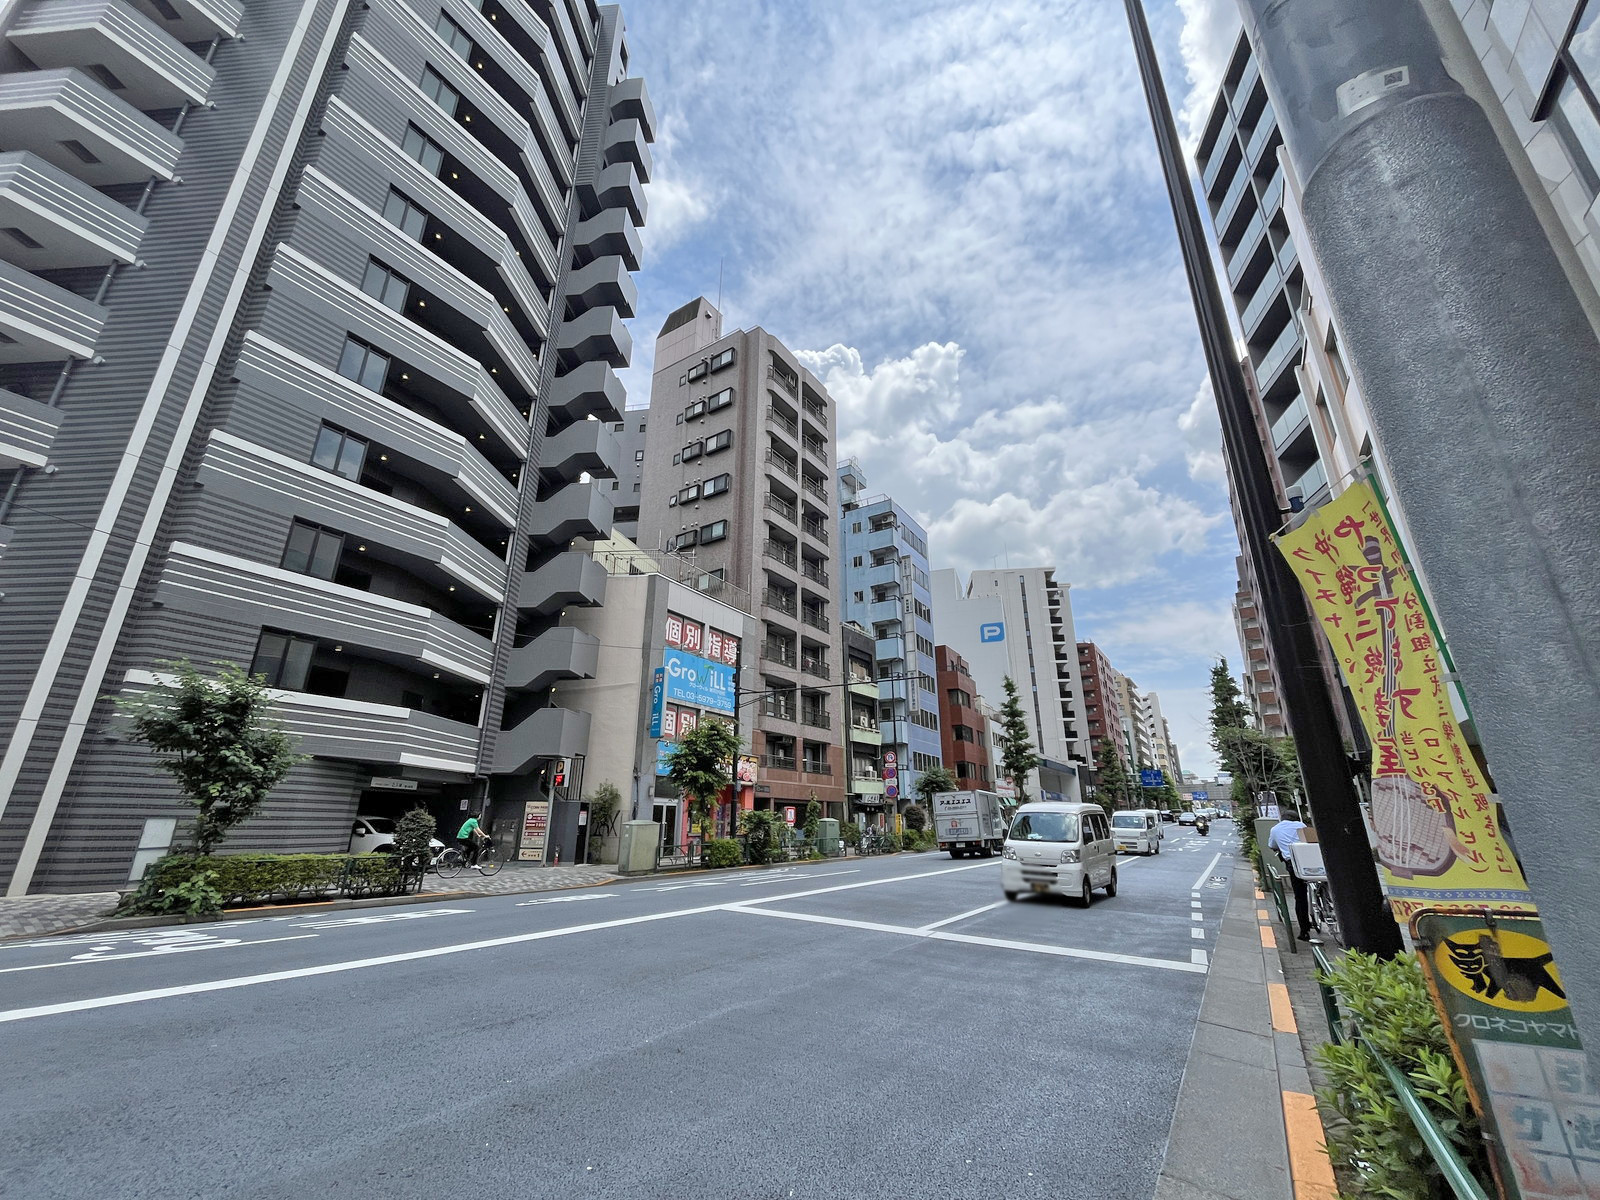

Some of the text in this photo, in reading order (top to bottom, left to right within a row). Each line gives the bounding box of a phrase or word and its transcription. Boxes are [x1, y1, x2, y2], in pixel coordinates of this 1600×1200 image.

[666, 617, 738, 665] 個別指導
[983, 625, 1001, 640] P
[673, 688, 686, 699] TEL
[1454, 1013, 1579, 1041] クロネコヤマト
